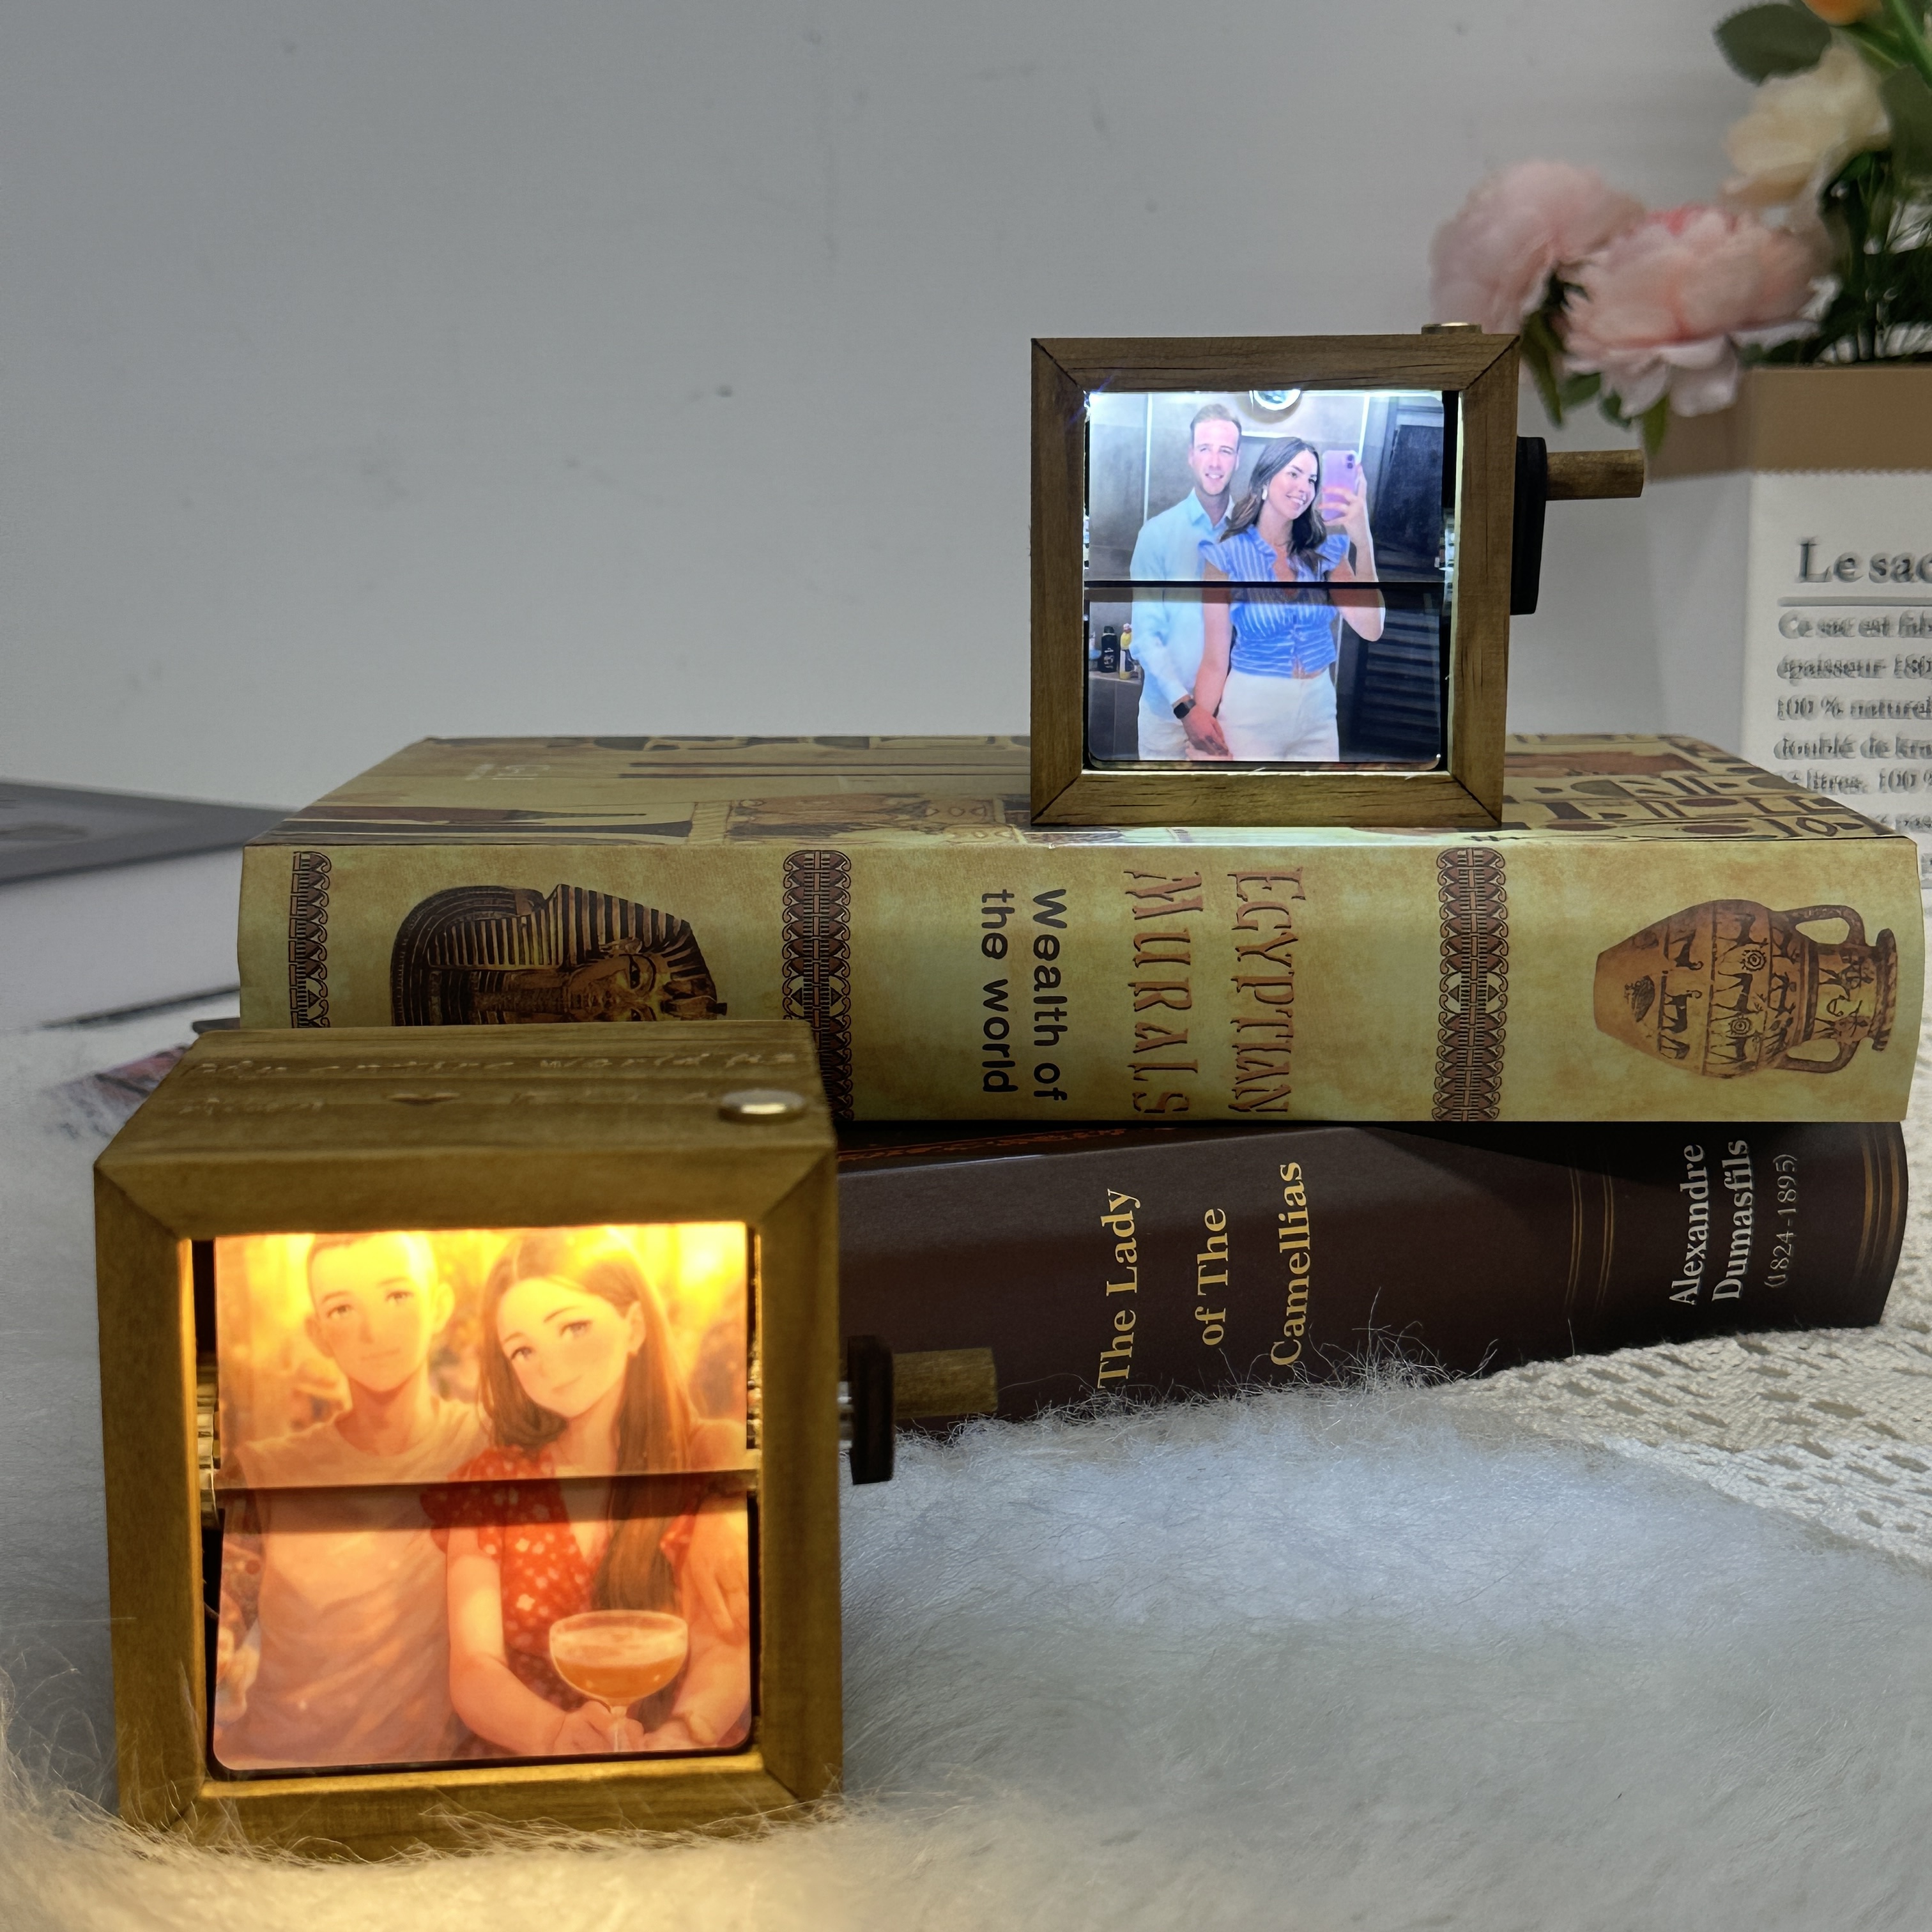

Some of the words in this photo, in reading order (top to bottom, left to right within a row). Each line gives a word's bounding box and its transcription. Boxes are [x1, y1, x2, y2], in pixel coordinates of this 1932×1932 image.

[1794, 537, 1863, 584] Le
[981, 889, 1015, 960] the
[1032, 889, 1068, 1046] Wealth
[982, 979, 1018, 1093] world
[1123, 870, 1204, 1114] MURALS
[1227, 867, 1306, 1113] EGYPTIAN
[1033, 1062, 1068, 1101] of
[1100, 1188, 1141, 1297] Lady
[1197, 1208, 1229, 1296] The
[1270, 1162, 1311, 1366] Camellias
[1669, 1144, 1710, 1305] Alexandre
[1764, 1154, 1798, 1289] (1824-1895)
[1097, 1309, 1137, 1390] The
[1195, 1306, 1226, 1346] of
